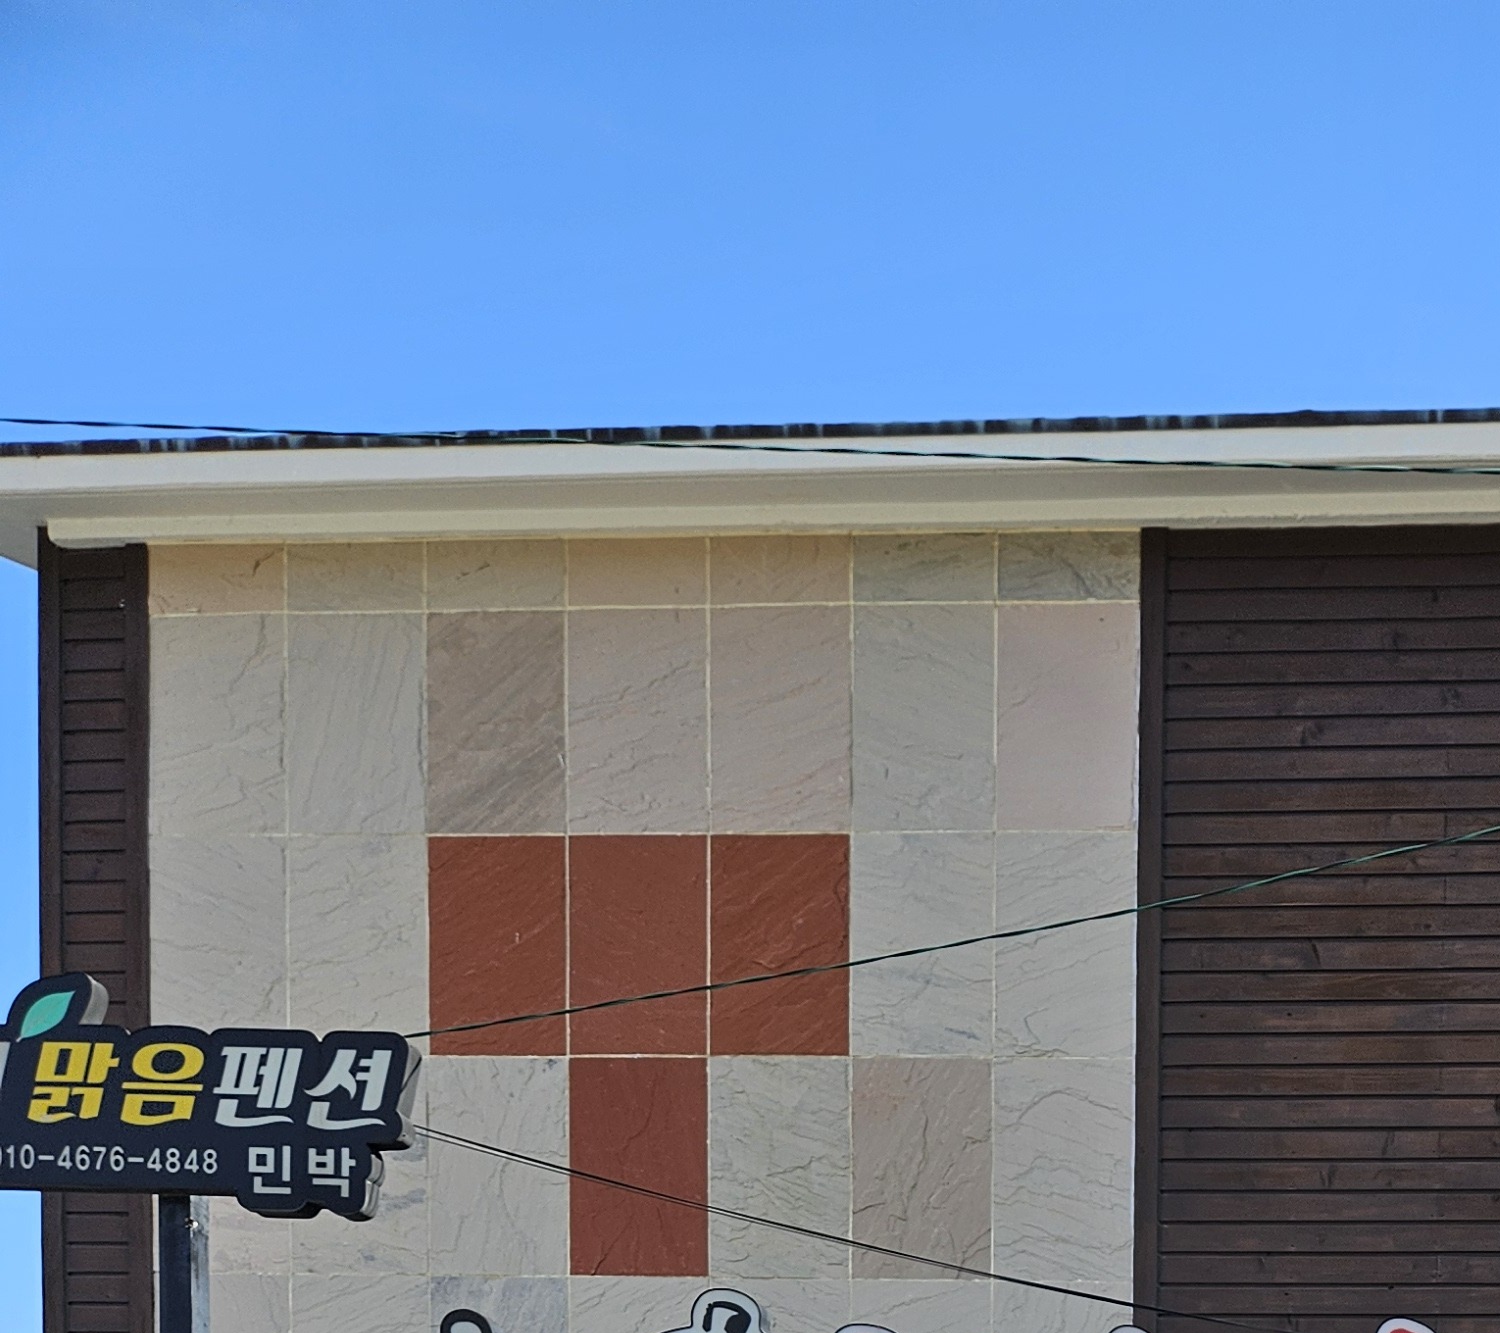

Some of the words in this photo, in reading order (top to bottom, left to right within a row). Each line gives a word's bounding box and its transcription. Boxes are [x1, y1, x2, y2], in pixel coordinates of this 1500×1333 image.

[27, 1041, 392, 1131] 맑음펜션
[0, 1143, 218, 1174] 10-4676-4848
[248, 1145, 356, 1198] 민박
